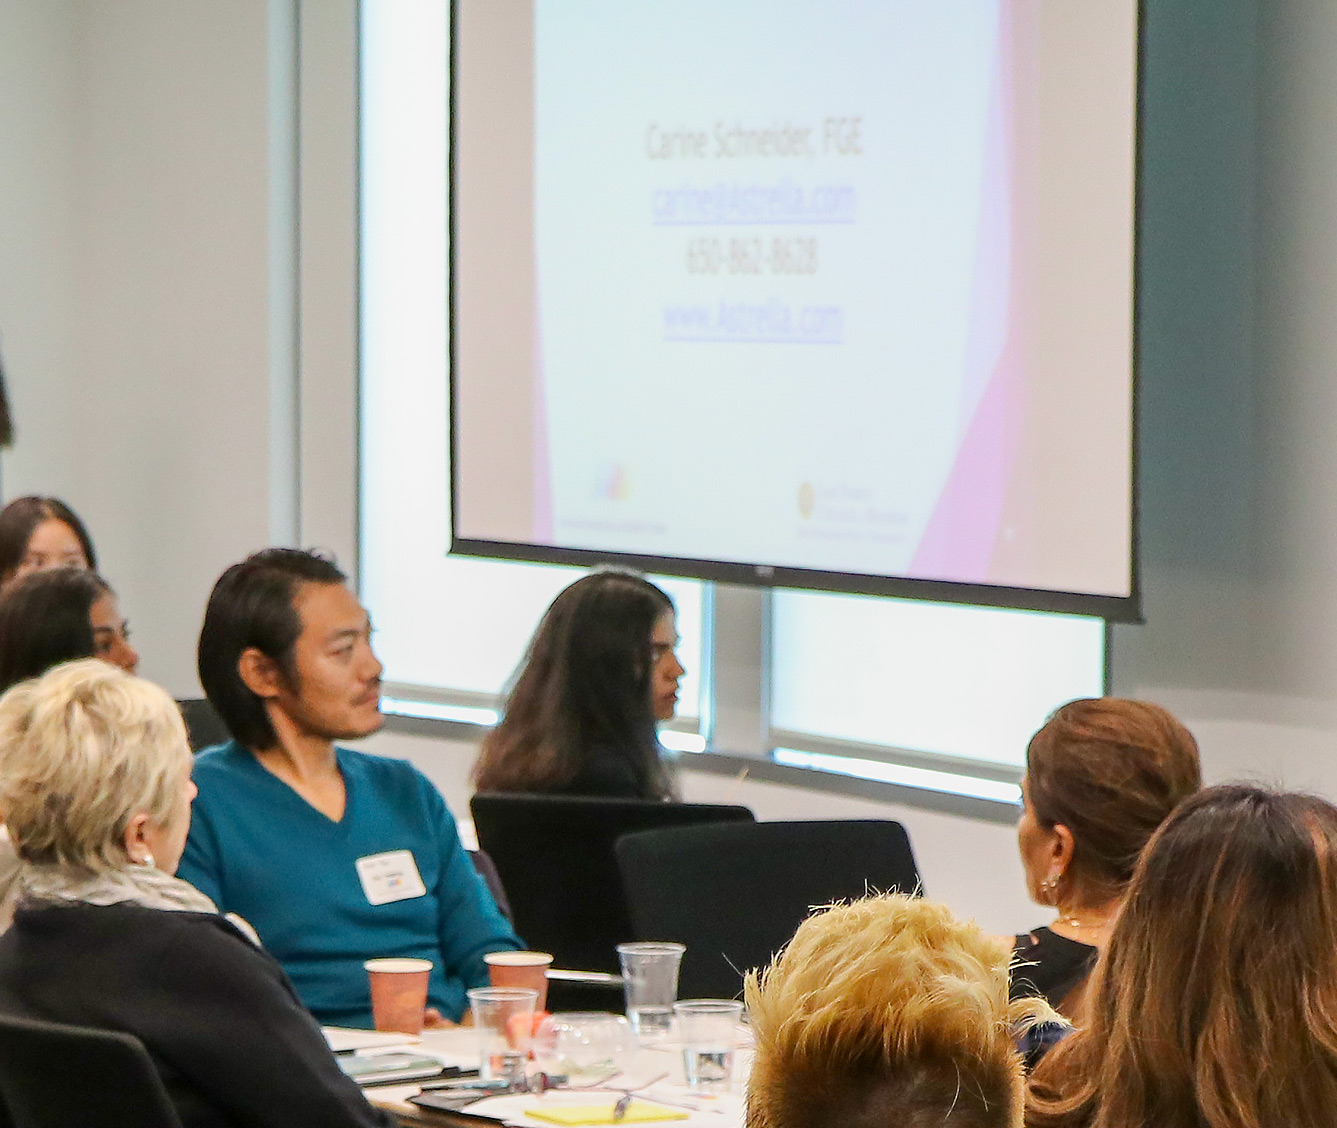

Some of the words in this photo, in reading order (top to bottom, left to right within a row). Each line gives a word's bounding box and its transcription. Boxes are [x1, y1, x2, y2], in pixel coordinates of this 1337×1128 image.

[645, 124, 707, 160] Carine
[714, 120, 815, 162] Schneider,
[824, 117, 865, 155] FGE
